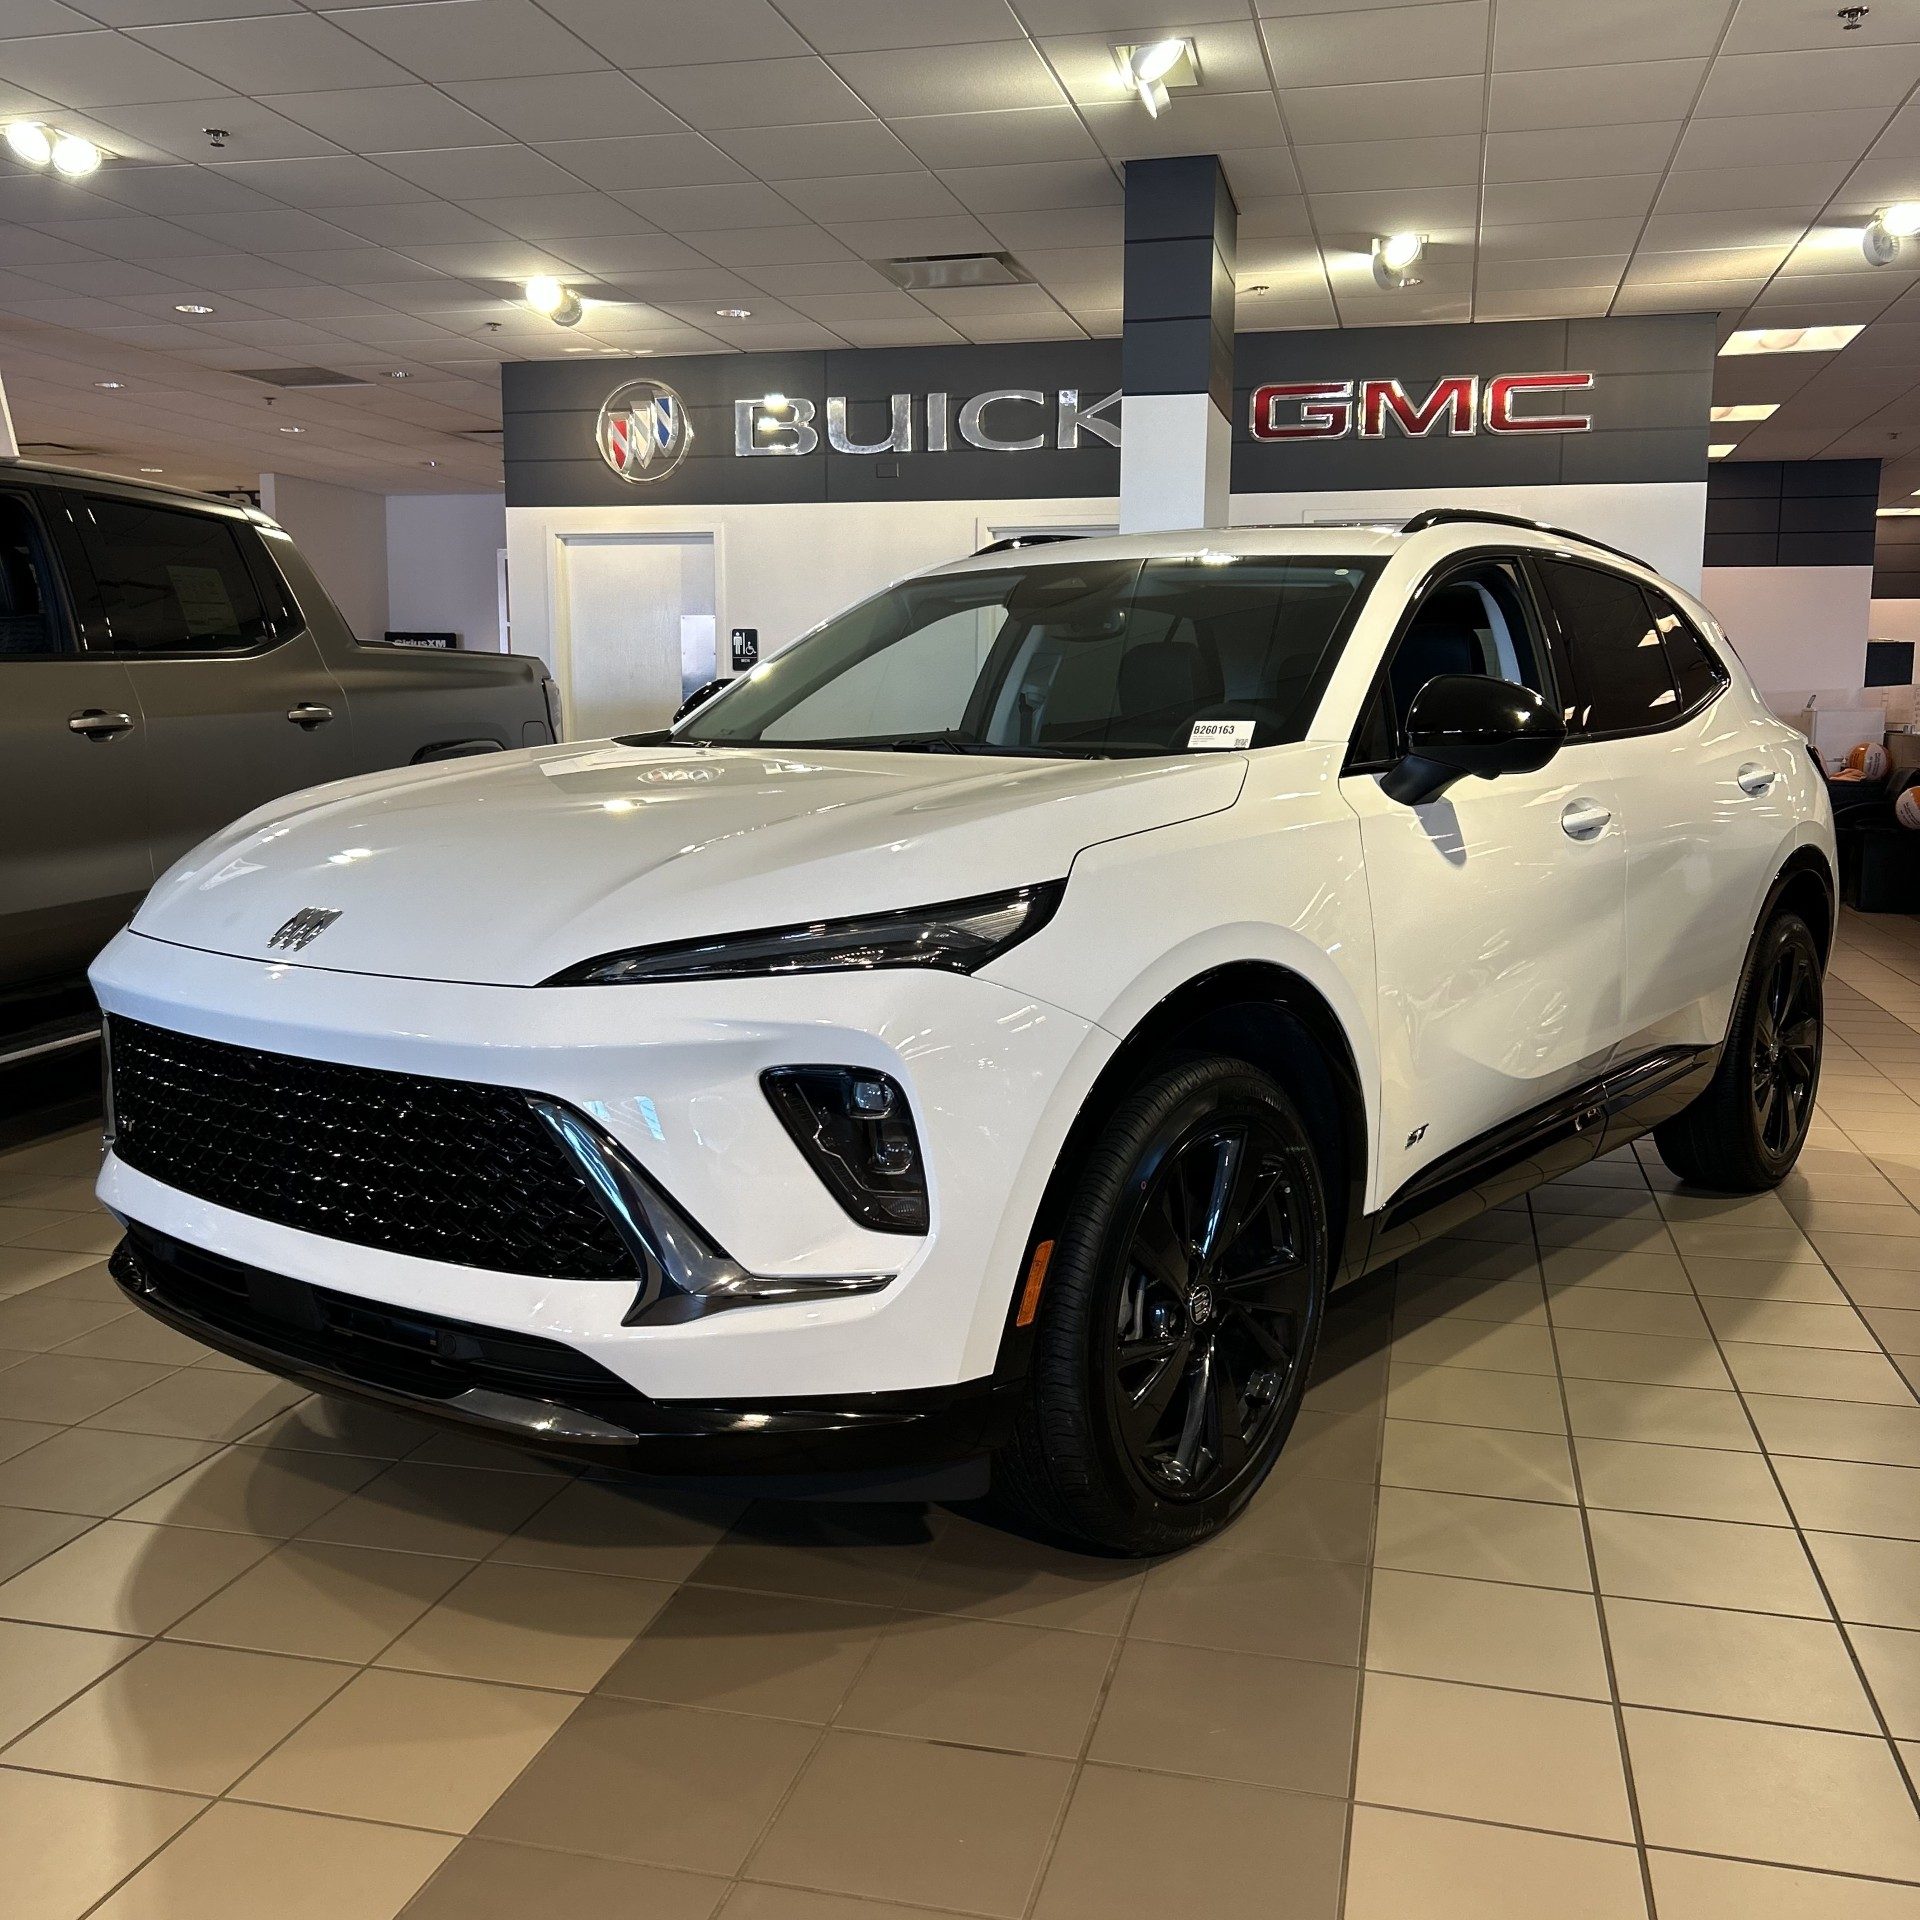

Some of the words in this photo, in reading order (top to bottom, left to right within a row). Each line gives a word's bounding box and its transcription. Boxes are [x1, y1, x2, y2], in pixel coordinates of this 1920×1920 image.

[735, 390, 1121, 457] BUICK
[1249, 371, 1596, 443] GMC
[1193, 725, 1235, 735] B260163
